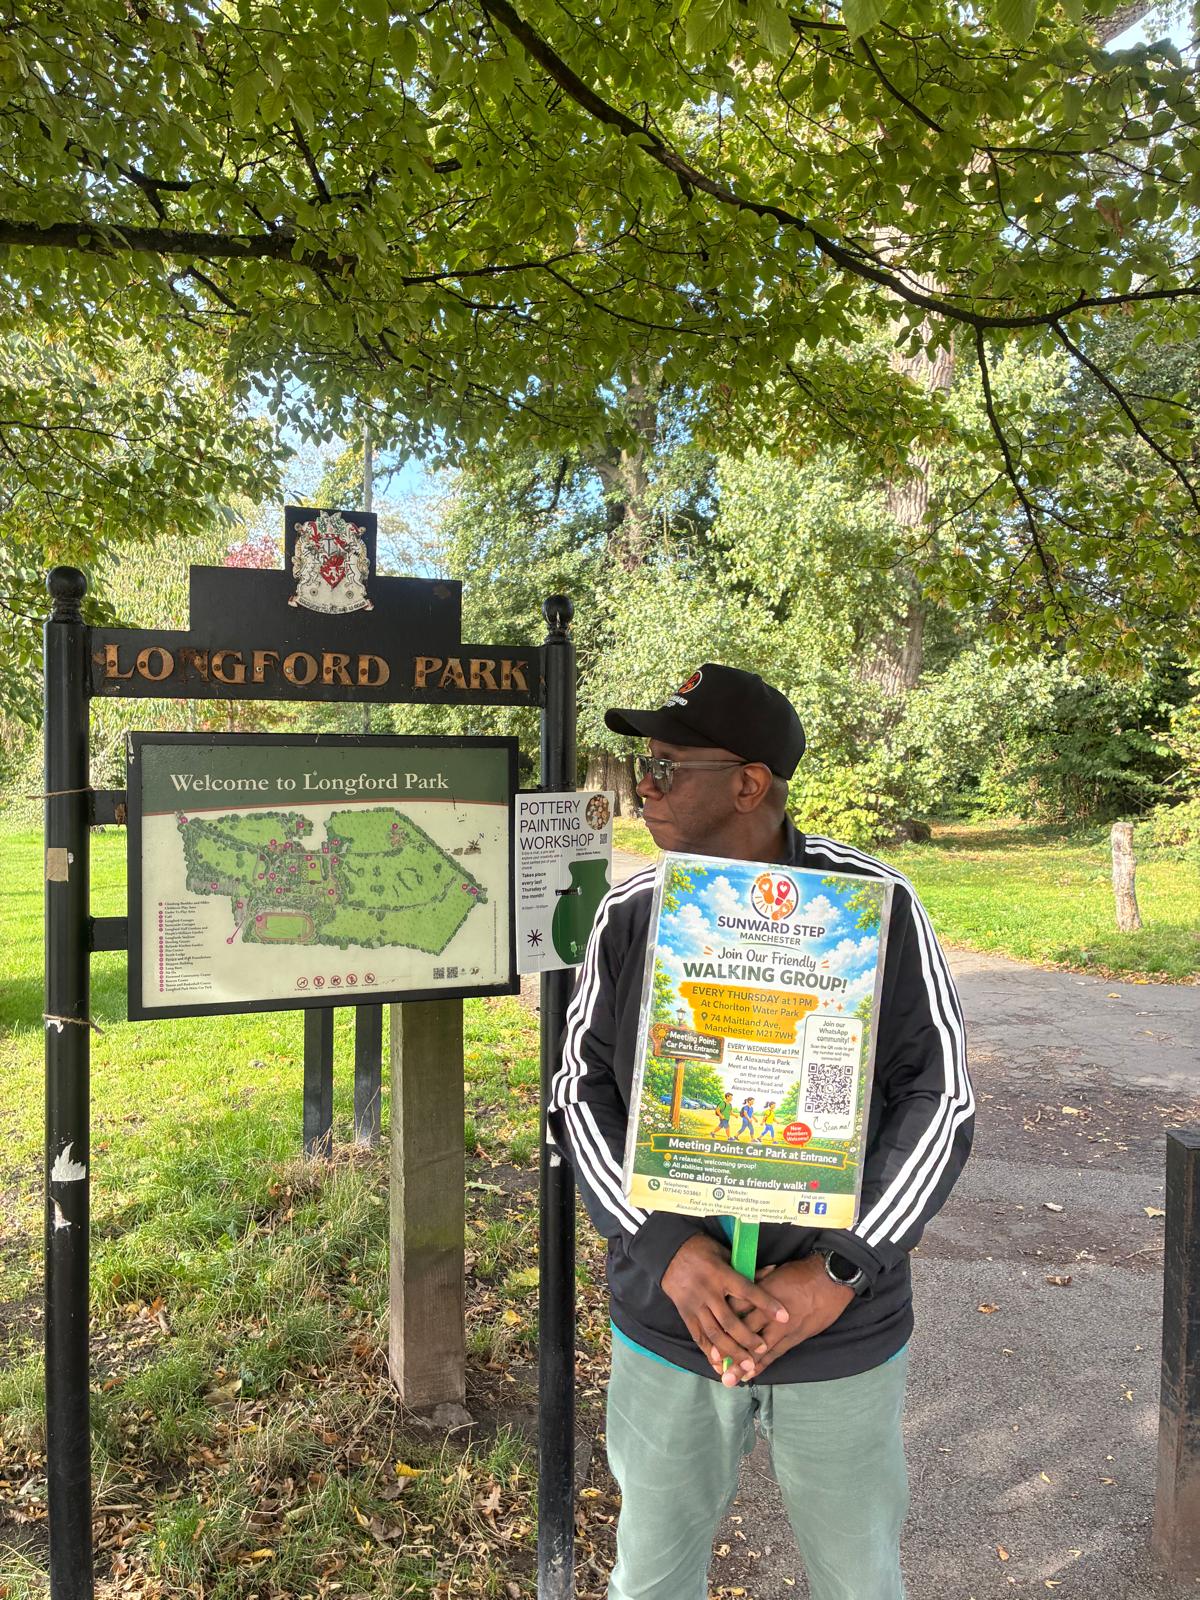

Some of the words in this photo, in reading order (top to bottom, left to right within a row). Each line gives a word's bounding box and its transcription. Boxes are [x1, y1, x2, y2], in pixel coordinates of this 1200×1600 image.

[414, 656, 529, 690] PARK
[170, 773, 269, 791] Welcome
[276, 778, 296, 791] to
[303, 772, 399, 796] Longford
[404, 772, 449, 791] Park
[520, 800, 580, 815] POTTERY
[520, 817, 580, 833] PAINTING
[520, 833, 595, 850] WORKSHOP
[717, 915, 790, 934] SUNWARD
[793, 924, 825, 938] STEP
[740, 932, 801, 945] MANCHESTER
[717, 946, 743, 960] Join
[746, 949, 768, 963] Our
[771, 951, 816, 972] Friendly
[683, 962, 775, 982] WALKING
[780, 969, 848, 993] GROUP!
[692, 986, 725, 997] EVERY
[727, 990, 780, 1004] THURSDAY
[781, 996, 791, 1005] at
[793, 997, 797, 1005] 1
[799, 998, 813, 1007] PM
[700, 999, 711, 1008] At
[713, 1000, 750, 1013] Chorlton
[752, 1004, 779, 1015] Water
[780, 1008, 800, 1017] Park
[710, 1013, 720, 1022] 74
[723, 1015, 761, 1027] Maitland
[762, 1020, 781, 1030] Ave,
[670, 1031, 697, 1045] Meeting
[698, 1035, 717, 1046] Point:
[704, 1023, 754, 1036] Manchester
[756, 1029, 772, 1038] M21
[775, 1030, 794, 1040] 7WH
[819, 1027, 849, 1037] WhatsApp
[665, 1040, 678, 1049] Car
[678, 1042, 693, 1050] Park
[693, 1044, 719, 1054] Entrance
[816, 1035, 850, 1045] community!
[727, 1042, 746, 1050] EVERY
[746, 1044, 781, 1054] WEDNESDAY
[744, 1055, 775, 1065] Alexandra
[772, 1067, 794, 1075] Entrance
[731, 1084, 757, 1093] Alexandra
[733, 1077, 760, 1085] Claremont
[822, 1121, 838, 1132] Scan
[839, 1120, 851, 1130] me!
[668, 1137, 711, 1153] Meeting
[713, 1142, 744, 1154] Point:
[745, 1146, 763, 1157] Car
[765, 1147, 787, 1159] Park
[788, 1151, 799, 1160] at
[800, 1151, 838, 1164] Entrance
[678, 1155, 703, 1164] relaxed,
[704, 1158, 736, 1169] welcoming
[737, 1162, 757, 1170] group!
[681, 1162, 703, 1171] abilities
[668, 1169, 695, 1180] Come
[696, 1172, 722, 1185] along
[723, 1175, 738, 1185] for
[747, 1177, 781, 1190] friendly
[783, 1181, 807, 1190] walk!
